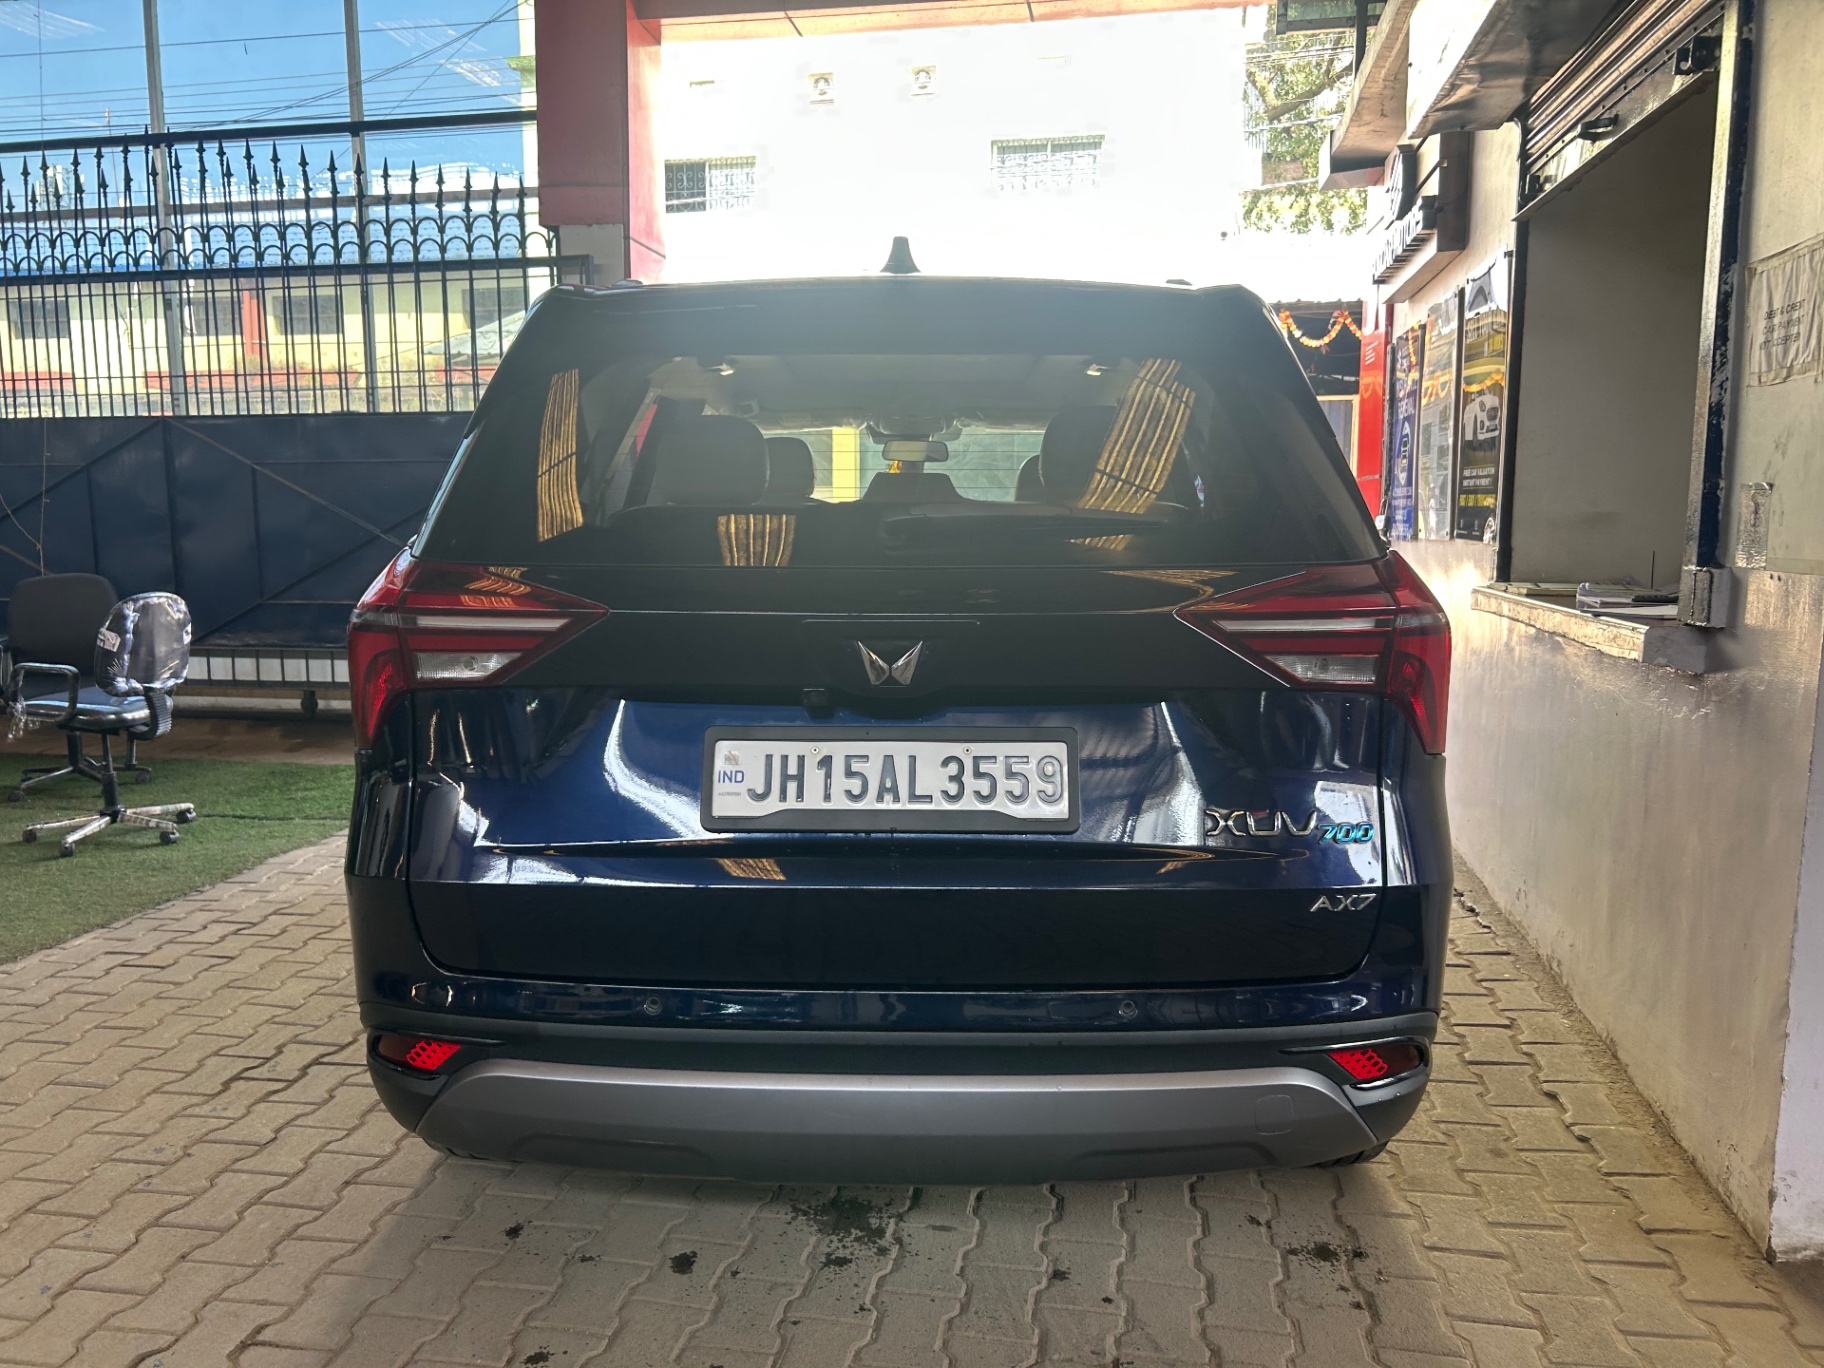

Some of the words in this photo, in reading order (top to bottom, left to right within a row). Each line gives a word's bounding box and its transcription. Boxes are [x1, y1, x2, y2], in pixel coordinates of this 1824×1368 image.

[1764, 308, 1780, 320] DET
[1786, 299, 1806, 314] CREDT
[1763, 324, 1778, 335] CAR
[1778, 314, 1805, 329] PAYET
[718, 770, 745, 784] IND
[747, 753, 1064, 803] JH15AL3559
[1310, 893, 1377, 912] AX7
